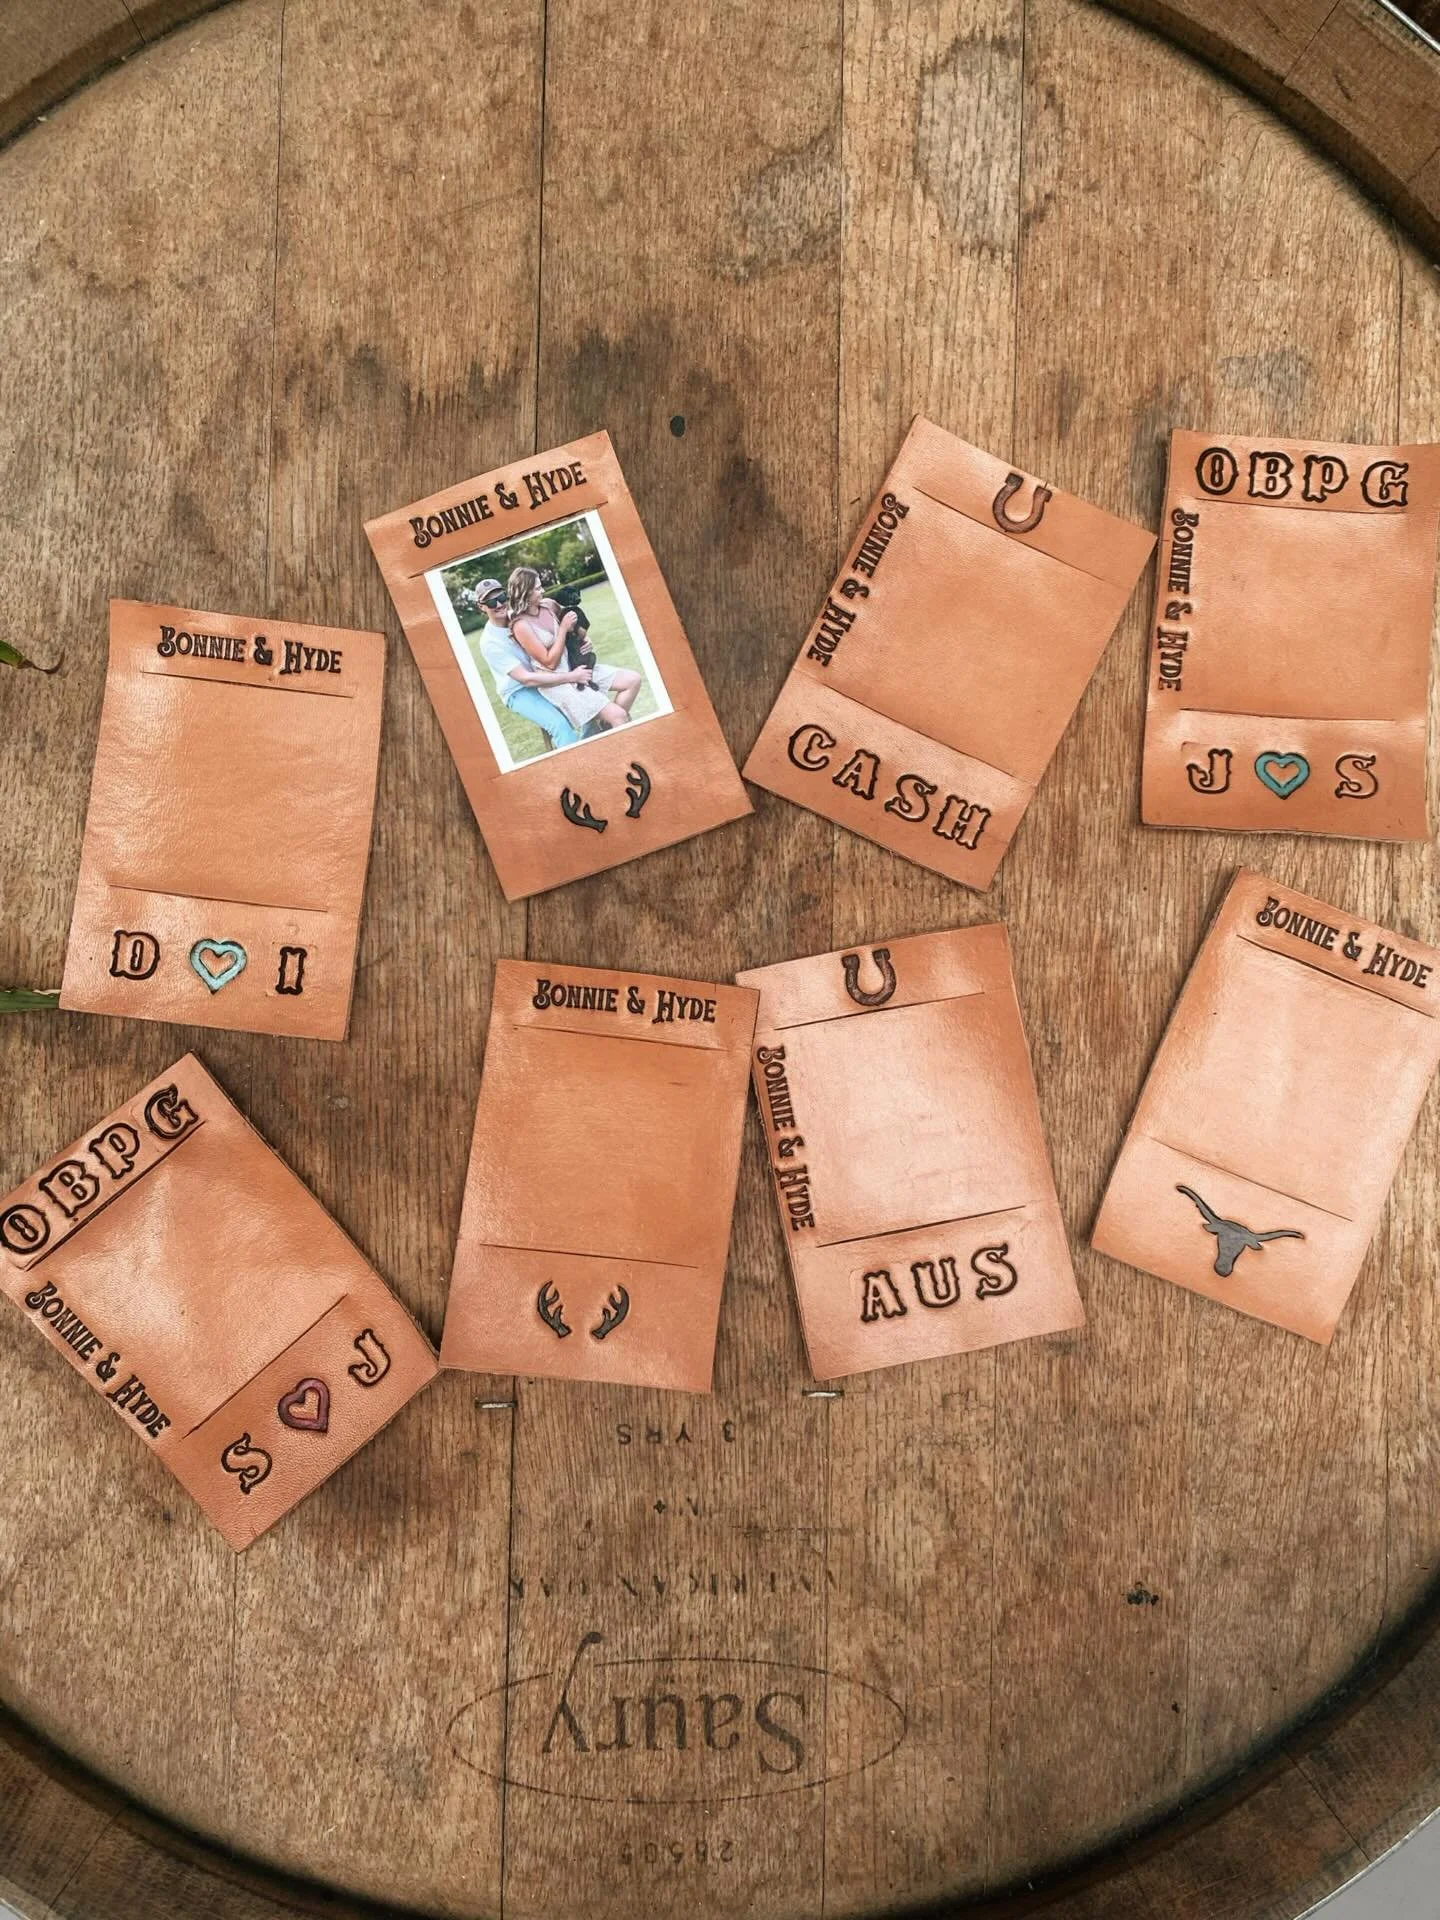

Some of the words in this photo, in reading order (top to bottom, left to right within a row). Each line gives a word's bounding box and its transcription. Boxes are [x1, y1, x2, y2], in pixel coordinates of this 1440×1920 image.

[408, 495, 495, 549] BONNIE
[494, 482, 519, 510] &
[522, 461, 587, 510] HYDE
[1195, 447, 1409, 508] OBPG
[852, 492, 910, 578] BONNIE
[1167, 507, 1200, 595] BONNIE
[840, 578, 870, 600] &
[1164, 600, 1193, 622] &
[157, 625, 246, 663] BONNIE
[253, 636, 272, 666] &
[279, 640, 342, 674] HYDE
[806, 596, 857, 667] HYDE
[1156, 625, 1191, 692] HYDE
[787, 723, 991, 850] CASH
[1186, 748, 1233, 794] J
[1335, 753, 1379, 799] S
[109, 929, 160, 980] D
[278, 945, 307, 996] I
[1255, 896, 1340, 951] BONNIE
[1342, 931, 1363, 962] &
[1363, 942, 1434, 989] HYDE
[532, 978, 618, 1013] BONNIE
[626, 985, 645, 1014] &
[651, 990, 717, 1024] HYDE
[756, 1045, 797, 1131] BONNIE
[0, 1083, 200, 1255] OBPG
[778, 1136, 806, 1158] &
[774, 1163, 816, 1232] HYDE
[860, 1243, 1019, 1323] AUS
[24, 1280, 104, 1361] BONNIE
[94, 1350, 121, 1382] &
[105, 1373, 171, 1439] HYDE
[220, 1432, 273, 1495] S
[348, 1327, 392, 1389] J
[541, 1631, 806, 1775] Saury
